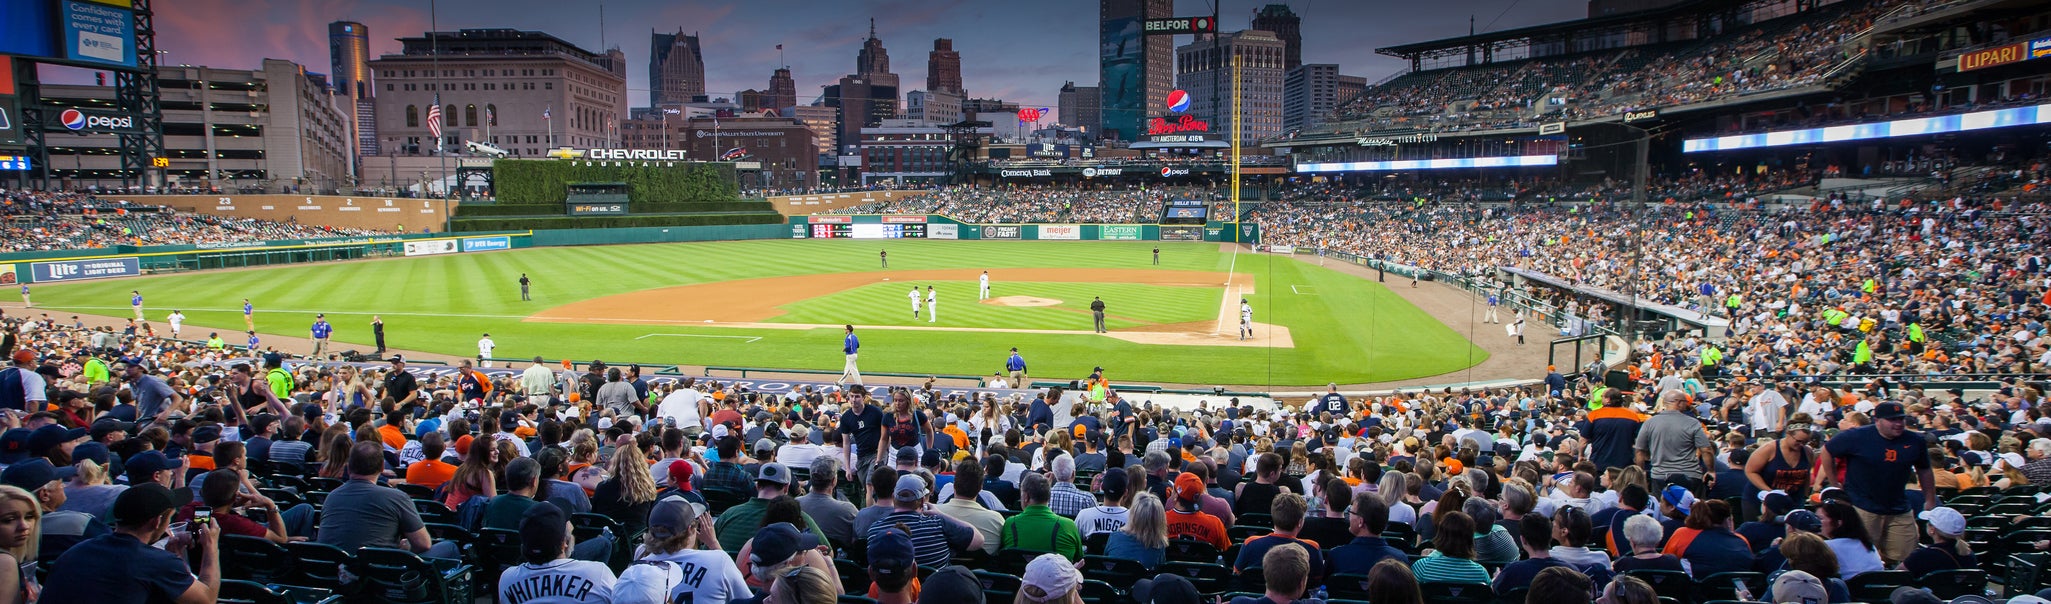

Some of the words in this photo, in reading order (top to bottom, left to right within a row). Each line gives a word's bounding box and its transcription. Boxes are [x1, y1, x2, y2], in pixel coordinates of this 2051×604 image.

[70, 3, 124, 18] Confidence
[71, 13, 103, 24] comes
[105, 18, 125, 28] with
[1145, 20, 1189, 31] BELFOR
[72, 21, 99, 32] every
[1967, 47, 2017, 68] LIPARI
[1019, 108, 1039, 121] AAA
[1630, 110, 1656, 120] LEXUS
[87, 116, 133, 130] pepsi
[1398, 136, 1417, 144] TIGER
[1422, 134, 1438, 143] CLUB
[590, 149, 687, 160] CHEVROLET
[2, 162, 10, 170] 6
[17, 162, 26, 170] 3
[1097, 168, 1123, 176] DETROIT
[1172, 168, 1189, 176] pepsi
[219, 197, 231, 205] 23
[346, 198, 353, 206] 2
[1046, 225, 1071, 235] meijer
[487, 240, 506, 248] Energy
[91, 261, 126, 269] ORIGINAL
[48, 263, 79, 279] Lite
[107, 267, 126, 275] BEER
[1328, 401, 1341, 411] 02
[857, 420, 865, 429] D
[1884, 448, 1897, 462] D
[504, 574, 594, 601] WHITAKER
